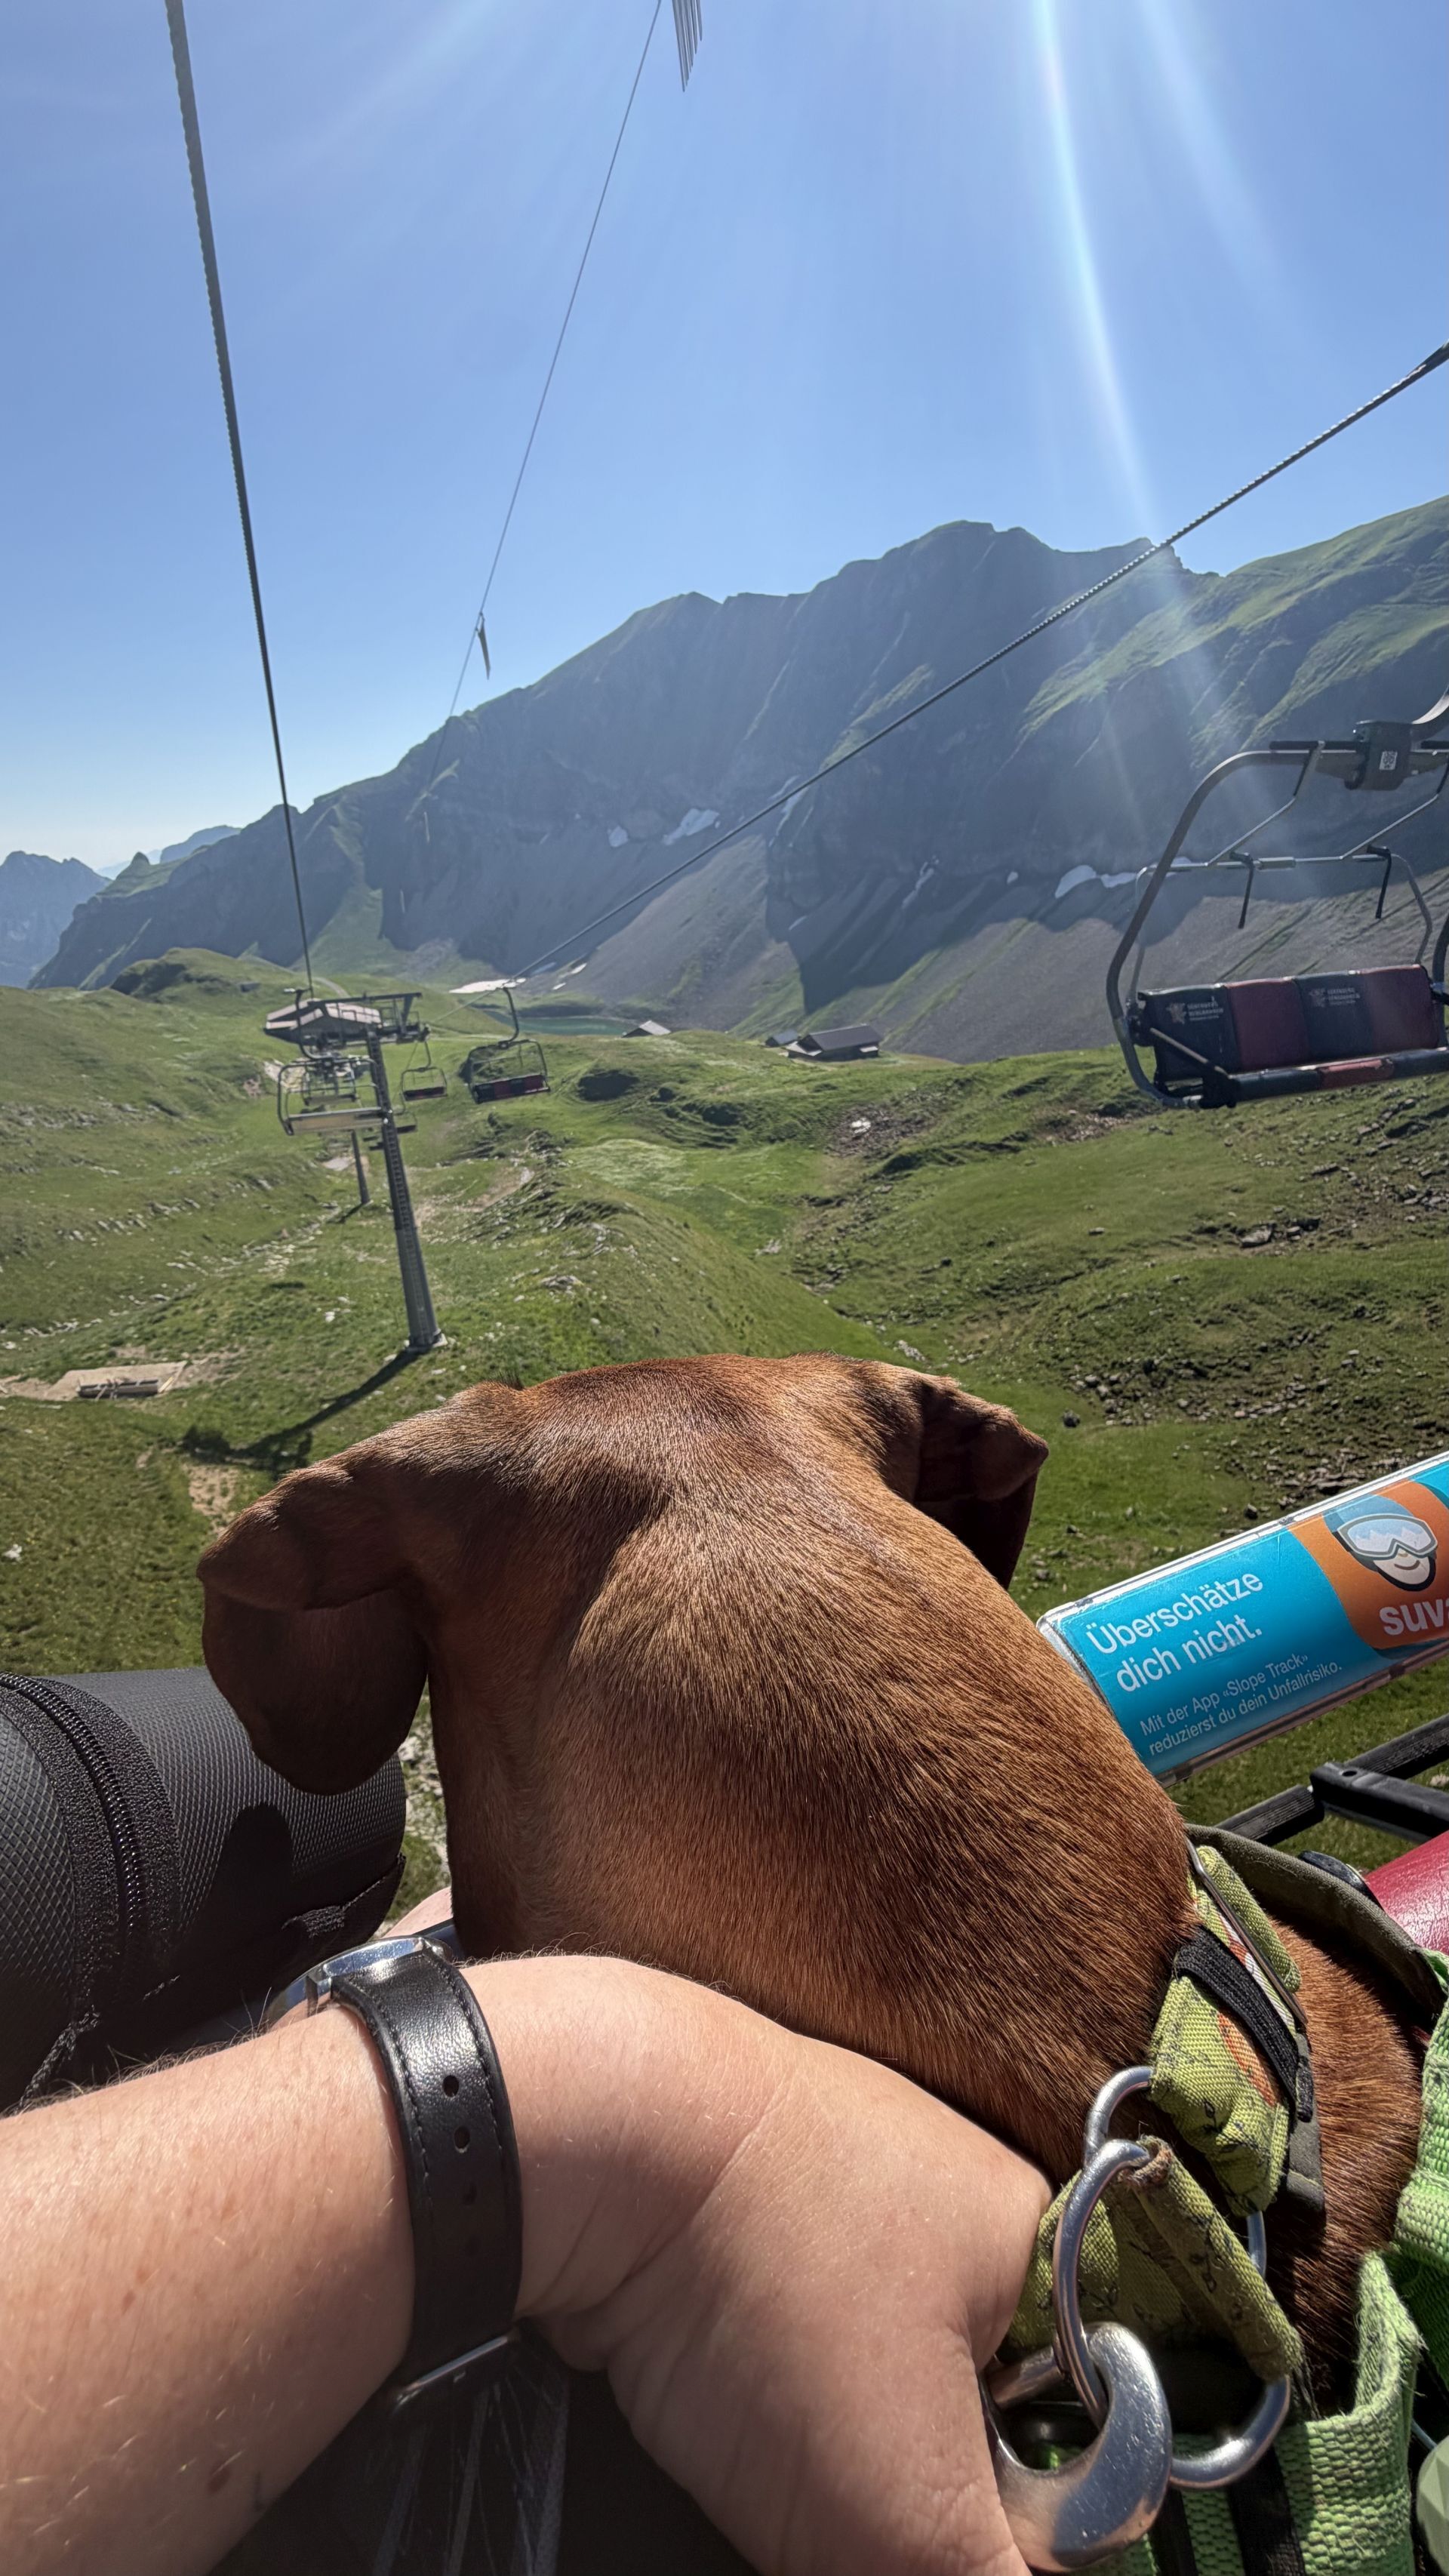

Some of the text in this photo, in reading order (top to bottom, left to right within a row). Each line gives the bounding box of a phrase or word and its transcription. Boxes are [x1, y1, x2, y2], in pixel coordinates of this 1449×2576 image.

[1086, 1573, 1263, 1654] Überschätze
[1116, 1614, 1263, 1692] dich nicht.
[1380, 1597, 1449, 1636] suv
[1140, 1653, 1309, 1736] Mit der App «Slope Track»
[1149, 1661, 1343, 1756] reduzierst du dein Unfallrisiko.
